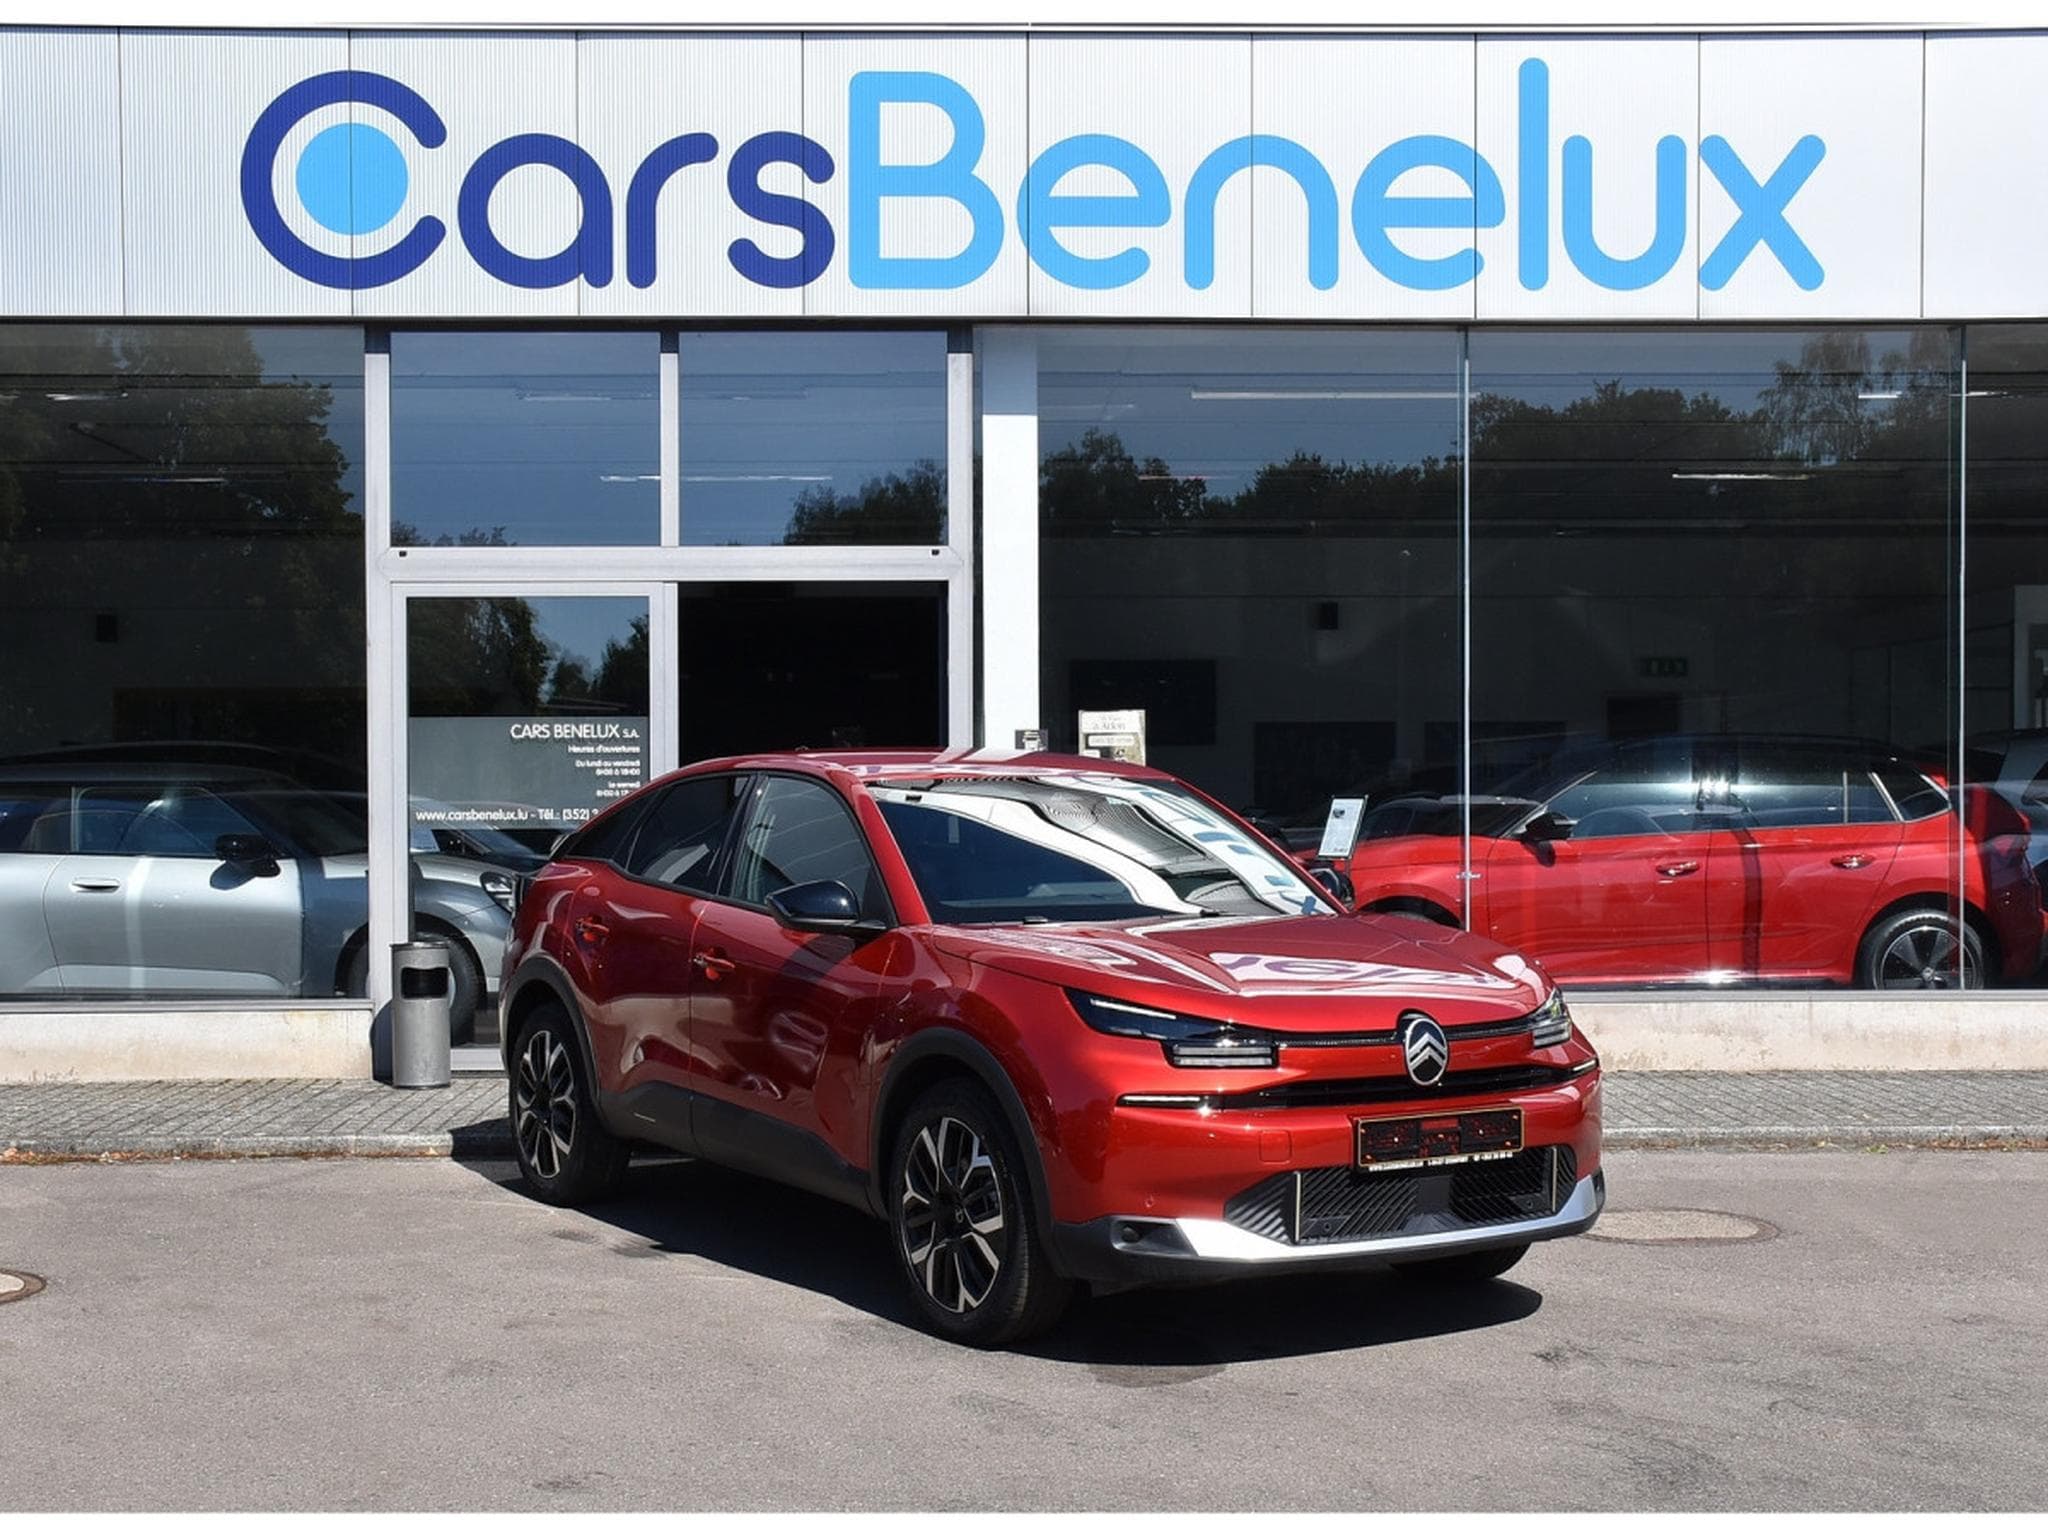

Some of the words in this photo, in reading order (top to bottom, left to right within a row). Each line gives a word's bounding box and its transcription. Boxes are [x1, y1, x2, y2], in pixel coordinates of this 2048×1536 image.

[510, 724, 550, 738] CARS
[554, 724, 620, 738] BENELUX
[622, 729, 640, 738] S.A.
[415, 808, 528, 821] www.carsbenelux.lu
[562, 808, 590, 821] (352)
